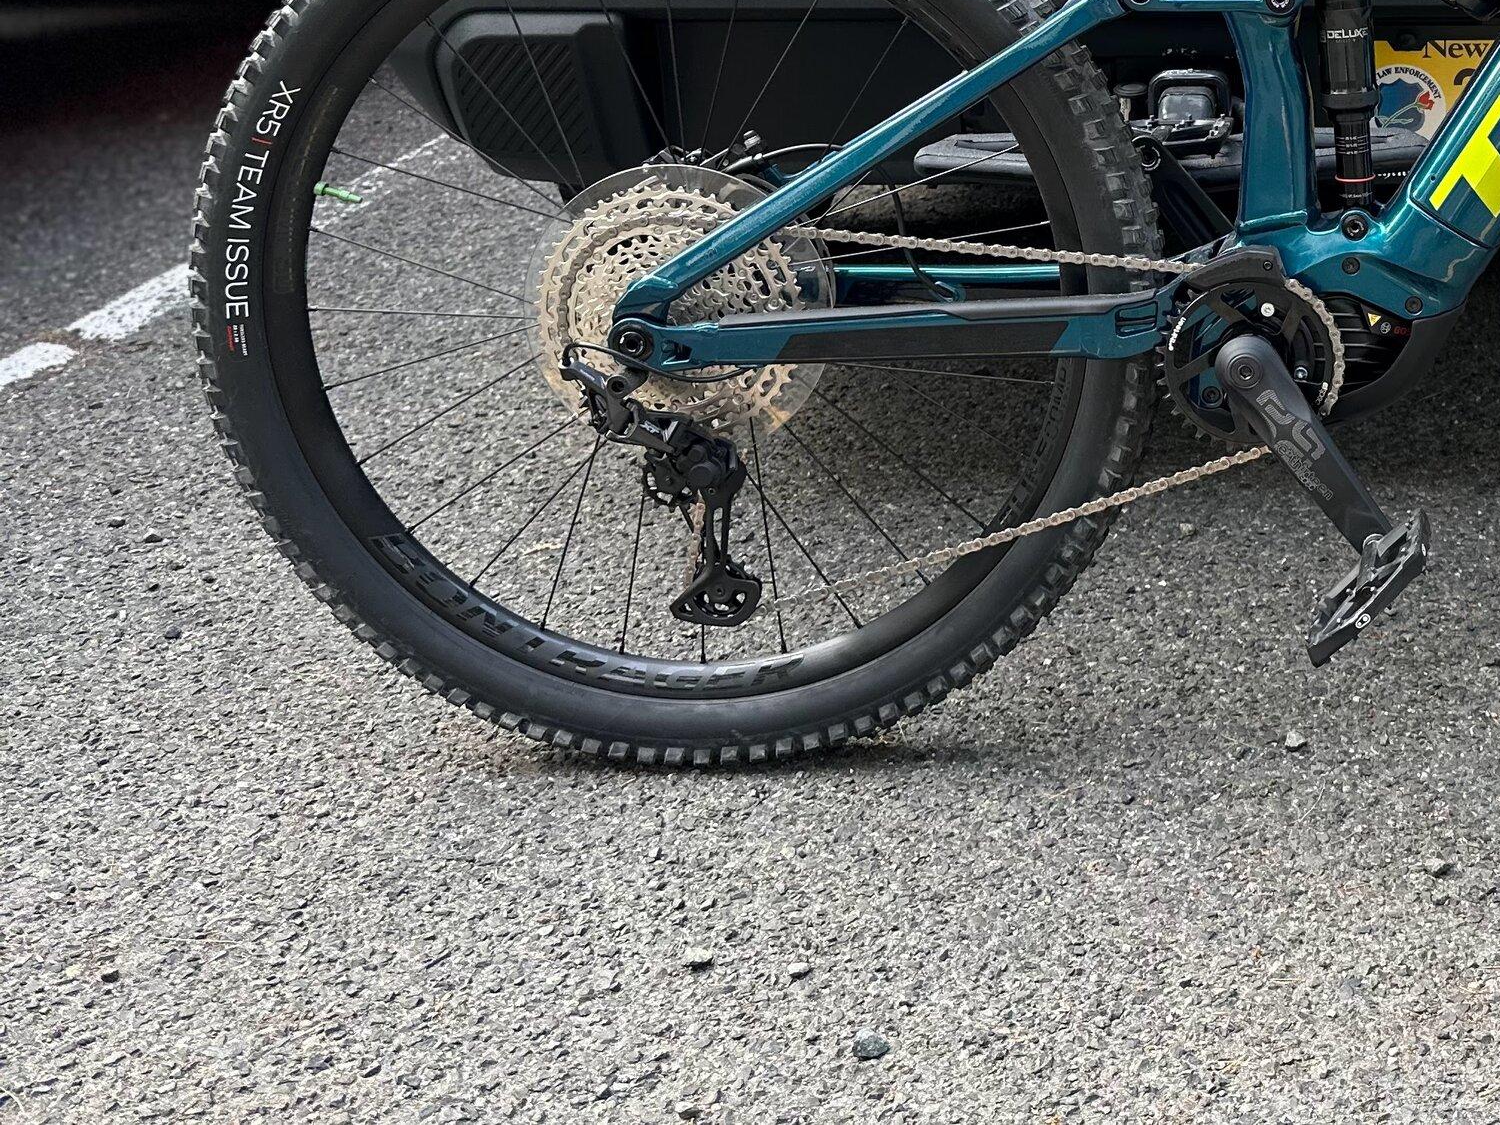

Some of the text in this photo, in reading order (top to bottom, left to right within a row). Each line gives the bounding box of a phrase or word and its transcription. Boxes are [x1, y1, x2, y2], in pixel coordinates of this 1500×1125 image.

[1326, 26, 1369, 41] DELUXE
[1422, 38, 1490, 59] New
[1376, 66, 1442, 100] LAW ENFORCEMENT
[255, 80, 302, 138] XR5
[228, 149, 271, 230] TEAM
[224, 238, 251, 320] ISSUE
